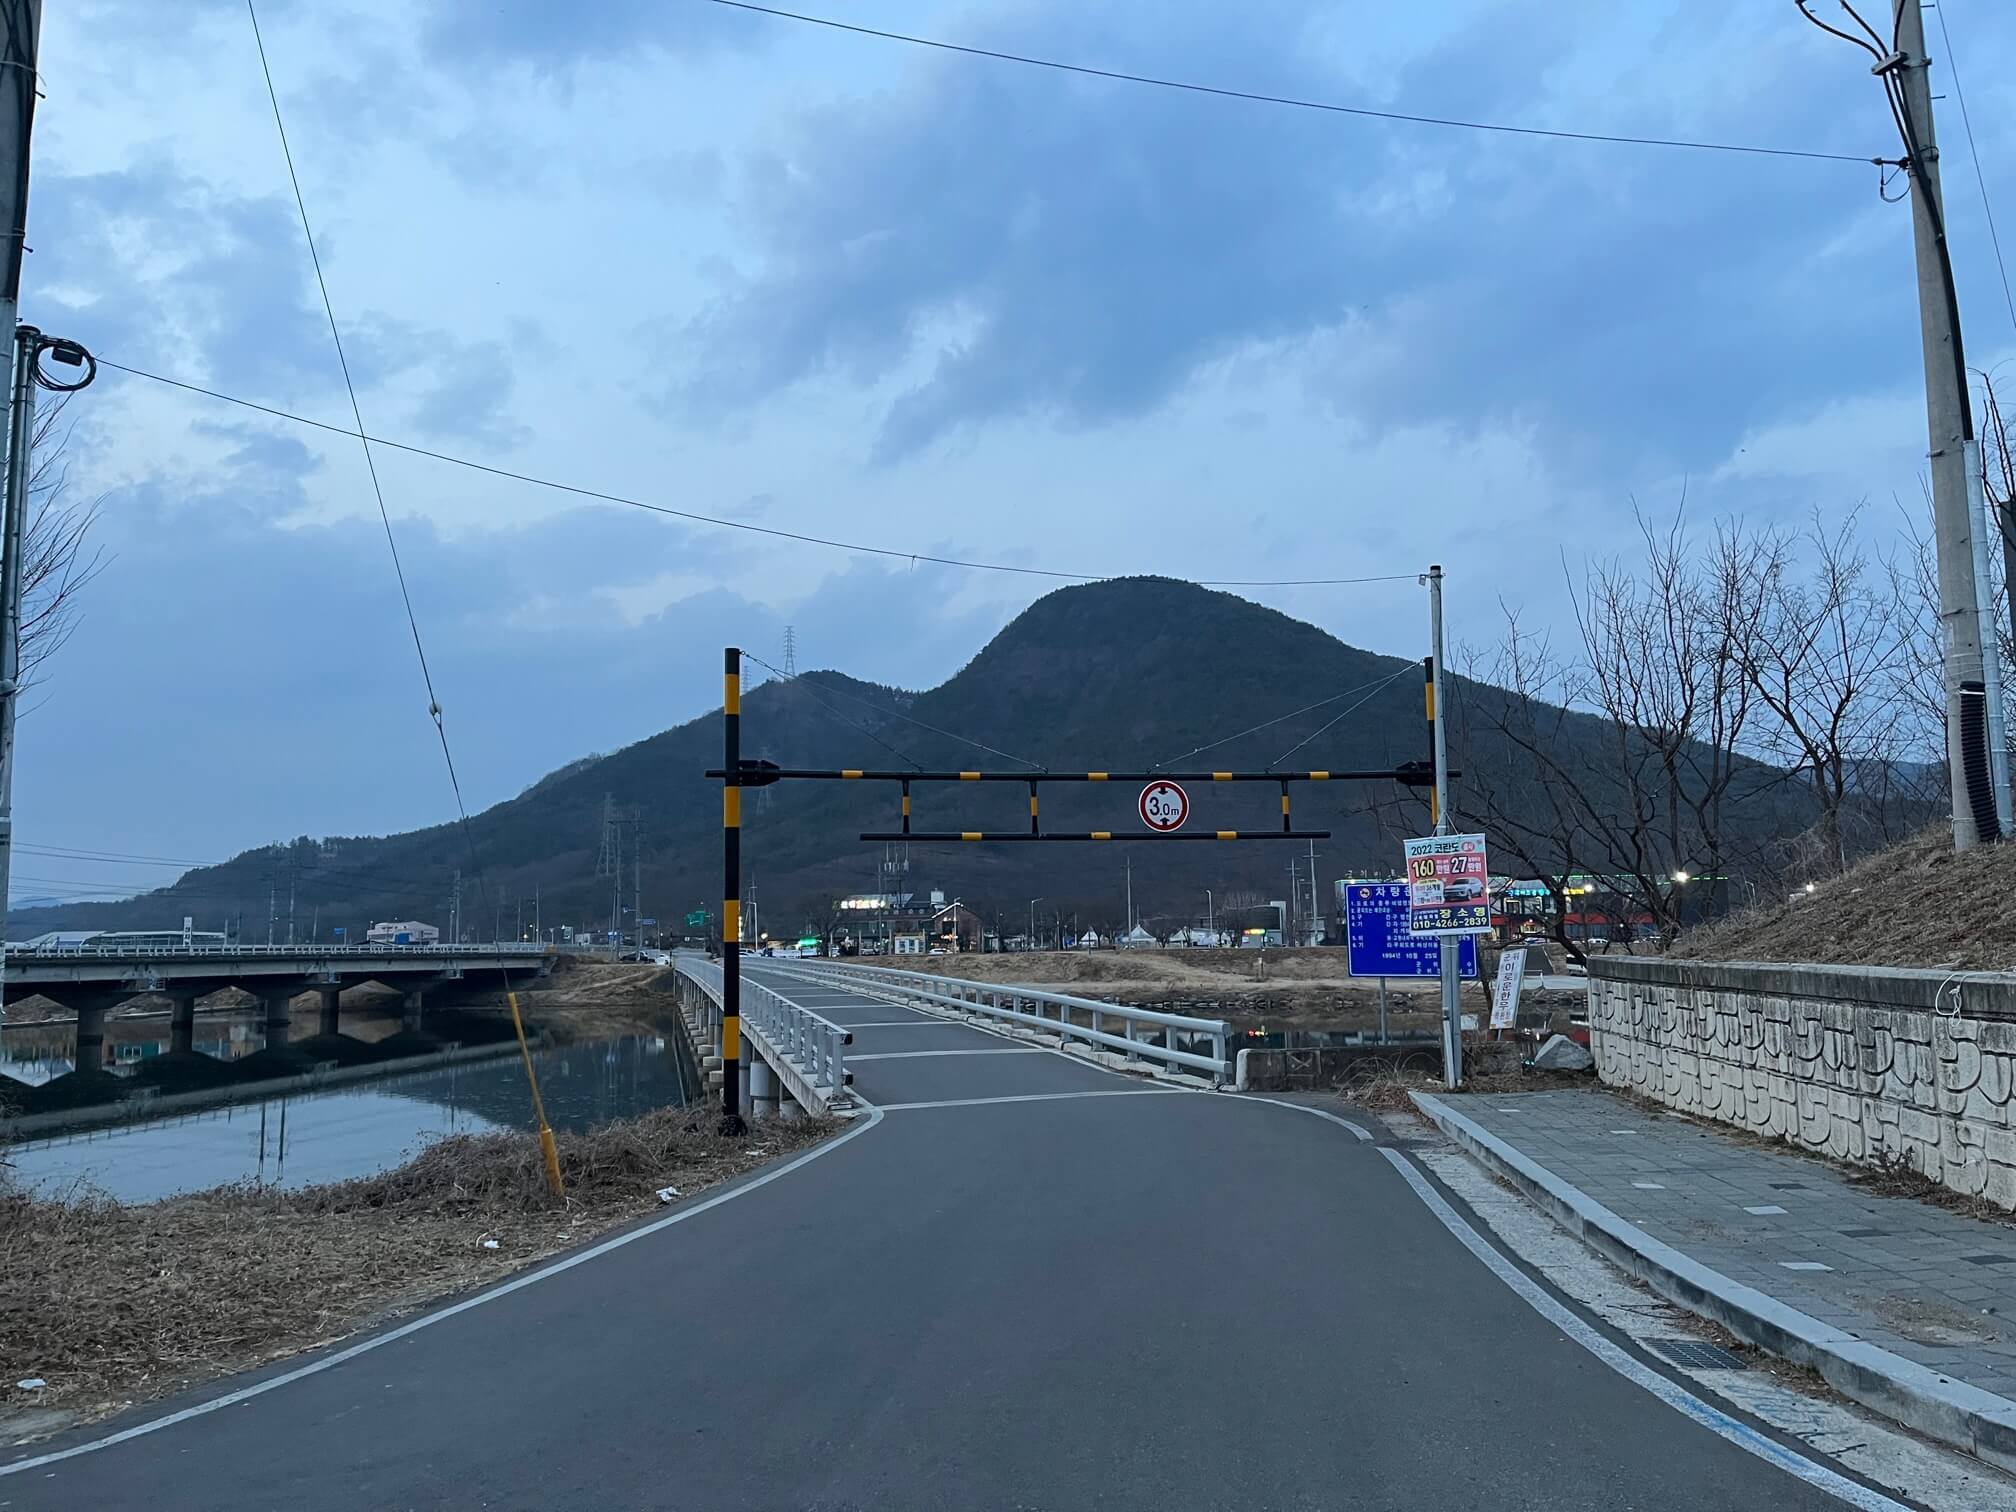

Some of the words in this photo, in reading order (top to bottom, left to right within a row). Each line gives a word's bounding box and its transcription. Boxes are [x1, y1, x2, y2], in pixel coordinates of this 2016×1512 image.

[1149, 796, 1179, 816] 3.0m
[1411, 845, 1432, 856] 2022
[1434, 842, 1459, 854] 코란도
[1412, 859, 1434, 878] 160
[1451, 856, 1467, 873] 27
[1413, 917, 1487, 929] 010-4266-2839
